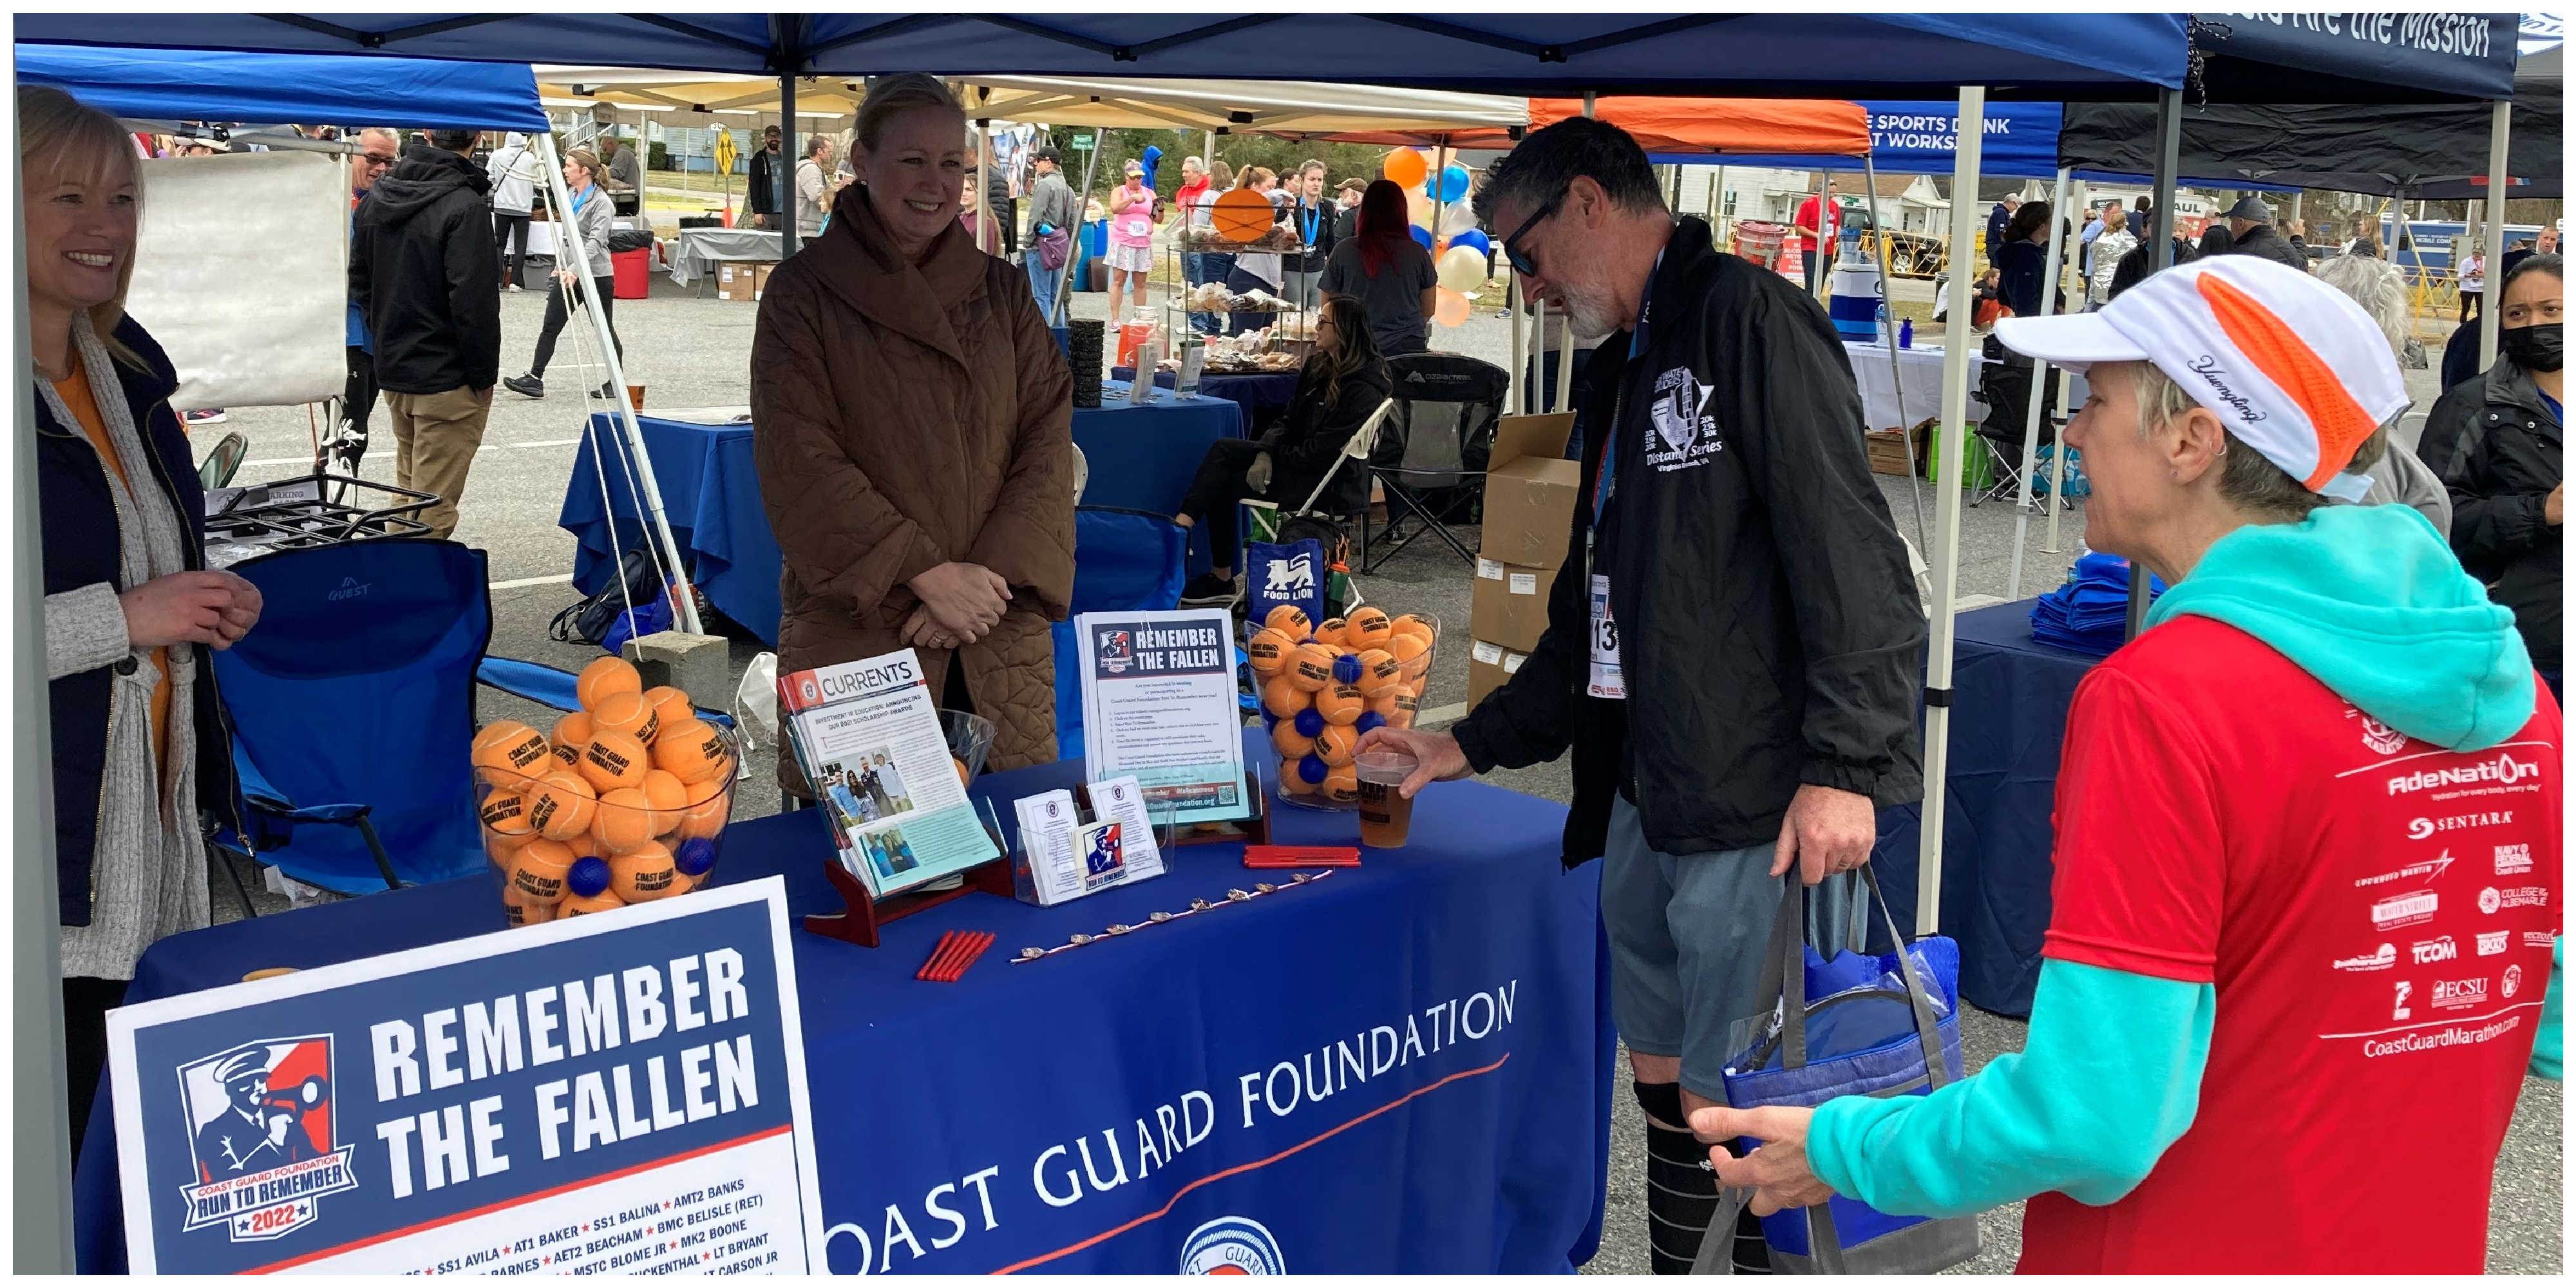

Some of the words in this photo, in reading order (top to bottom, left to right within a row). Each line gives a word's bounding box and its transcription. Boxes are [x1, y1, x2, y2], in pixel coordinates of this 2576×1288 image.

[2401, 13, 2490, 57] Mission
[1877, 115, 1947, 133] SPORTS
[1952, 118, 2010, 134] DNK
[2187, 355, 2267, 424] Yuengling
[1690, 440, 1723, 457] Series
[269, 491, 305, 500] ARKING
[1264, 589, 1289, 600] FOOD
[1293, 587, 1314, 600] LION
[1136, 628, 1217, 649] REMEMBER
[1137, 652, 1164, 670] THE
[1169, 649, 1220, 669] FALLEN
[822, 661, 913, 697] CURRENTS
[886, 694, 922, 708] ANNOUNCING
[890, 704, 913, 715] AWARDS
[508, 742, 529, 761] COAST
[591, 741, 610, 757] COAST
[607, 751, 630, 768] GUARD
[585, 751, 625, 777] FOUNDATION
[2438, 811, 2513, 831] SENTARA
[516, 868, 537, 886] COAST
[538, 877, 562, 889] GUARD
[635, 872, 658, 882] COAST
[2401, 866, 2432, 878] MARTIN
[2501, 887, 2538, 899] COLLEGE
[2501, 896, 2546, 908] ALBEMARLE
[2413, 941, 2458, 965] TCOM
[2447, 977, 2489, 997] ECSU
[370, 947, 749, 1103] REMEMBER
[2364, 1016, 2521, 1058] CoastGuardMarathon.com
[376, 1095, 510, 1199] THE
[535, 1033, 759, 1160] FALLEN
[824, 1165, 1000, 1275] OAST
[1033, 1090, 1214, 1208] GUARD
[1240, 979, 1518, 1128] FOUNDATION
[197, 1180, 232, 1197] COAST
[236, 1171, 272, 1188] GUARD
[274, 1155, 339, 1179] FOUNDATION
[196, 1193, 231, 1218] RUN
[233, 1187, 256, 1208] TO
[258, 1163, 343, 1202] REMEMBER
[252, 1204, 296, 1233] 2022
[437, 1256, 462, 1275] SS1
[465, 1247, 500, 1267] AVILA
[514, 1238, 535, 1254] AT1
[539, 1226, 579, 1247] BAKER
[593, 1215, 616, 1231] SS1
[619, 1202, 661, 1224] BALINA
[674, 1191, 705, 1209] AMT2
[708, 1179, 745, 1198] BANKS
[554, 1245, 583, 1265] AET2
[586, 1227, 643, 1255] BEACHAM
[657, 1216, 685, 1235] BMC
[687, 1203, 733, 1227] BELISLE
[735, 1194, 764, 1215] (RET)
[574, 1259, 607, 1275] MSTC
[611, 1247, 652, 1269] BLOME
[654, 1242, 667, 1256] JR
[681, 1231, 706, 1249] MK2
[709, 1219, 748, 1240] BOONE
[714, 1246, 726, 1260] LT
[728, 1233, 770, 1255] BRYANT
[718, 1255, 762, 1275] CARSON
[766, 1251, 779, 1264] JR
